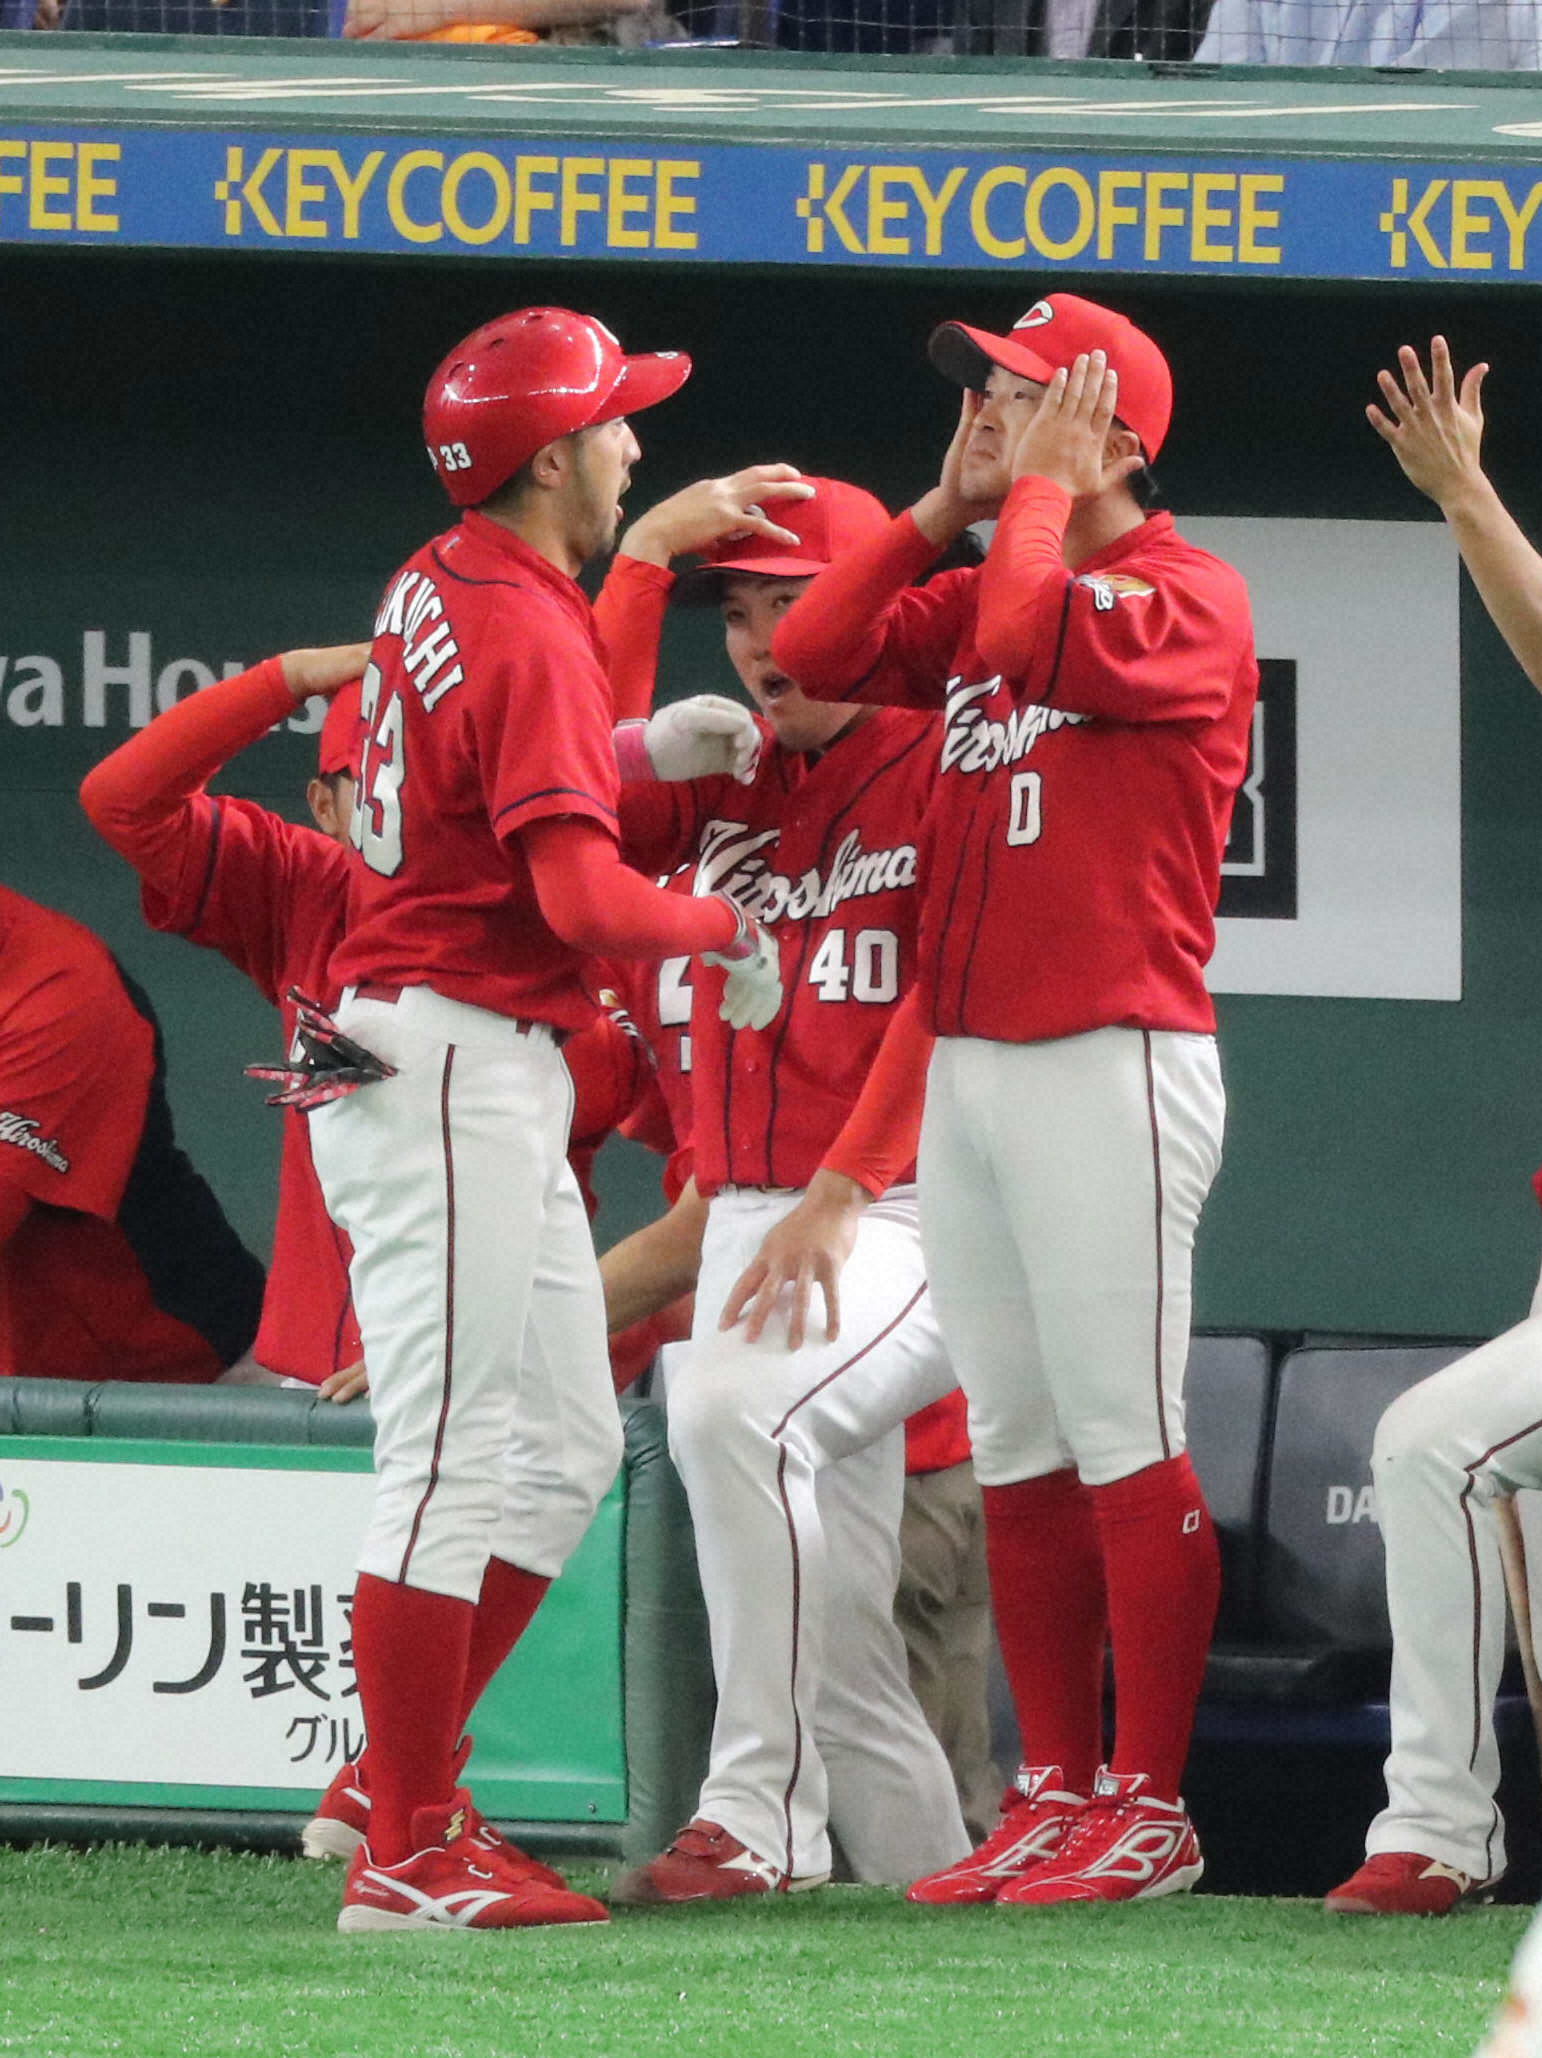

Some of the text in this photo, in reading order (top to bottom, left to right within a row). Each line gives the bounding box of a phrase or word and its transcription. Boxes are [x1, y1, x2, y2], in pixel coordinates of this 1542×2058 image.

[440, 442, 472, 471] 33
[1006, 771, 1042, 846] 0
[809, 929, 898, 1003] 40
[10, 1581, 358, 1701] ーリン製
